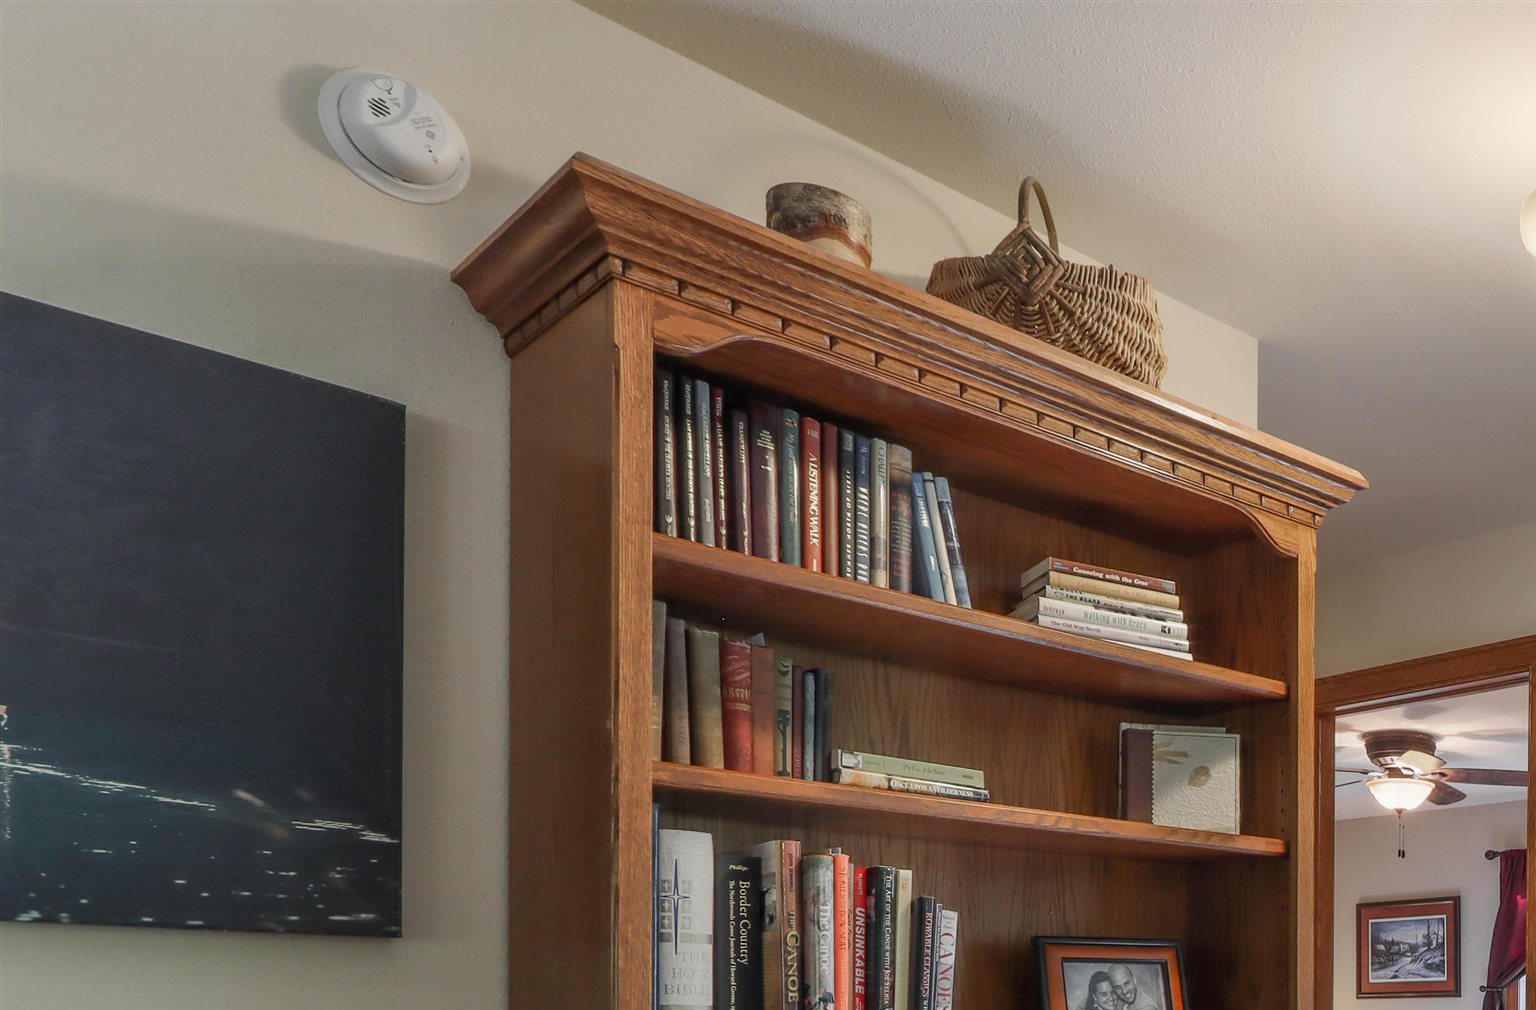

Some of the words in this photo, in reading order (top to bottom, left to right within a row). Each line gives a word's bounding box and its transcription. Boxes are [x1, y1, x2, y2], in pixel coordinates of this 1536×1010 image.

[809, 462, 819, 515] LISTENING
[846, 497, 852, 509] OF
[856, 486, 869, 518] WHERE
[809, 516, 820, 546] WALK
[856, 521, 869, 558] RIVERS
[1072, 566, 1104, 579] Canoeing
[1105, 573, 1120, 582] with
[1121, 576, 1132, 584] the
[1079, 596, 1101, 605] BEARS
[1083, 610, 1111, 624] Walking
[1112, 616, 1127, 626] with
[838, 867, 847, 899] STORIES
[884, 874, 893, 890] THE
[738, 880, 750, 917] Border
[884, 890, 892, 902] ART
[819, 902, 831, 929] The
[884, 904, 891, 913] OF
[736, 919, 751, 965] Country
[838, 931, 847, 950] SEAT
[884, 927, 892, 949] CANOE
[924, 912, 934, 955] ROWABLE
[728, 936, 736, 958] Journals
[819, 930, 832, 976] Canoe
[855, 906, 865, 995] UNSINKABLE
[729, 965, 737, 985] Howard
[786, 929, 800, 1003] CANOE
[883, 969, 891, 981] JOE
[921, 957, 932, 997] CLASSICS
[663, 984, 710, 996] BIBLE
[883, 982, 891, 1005] SELIGA
